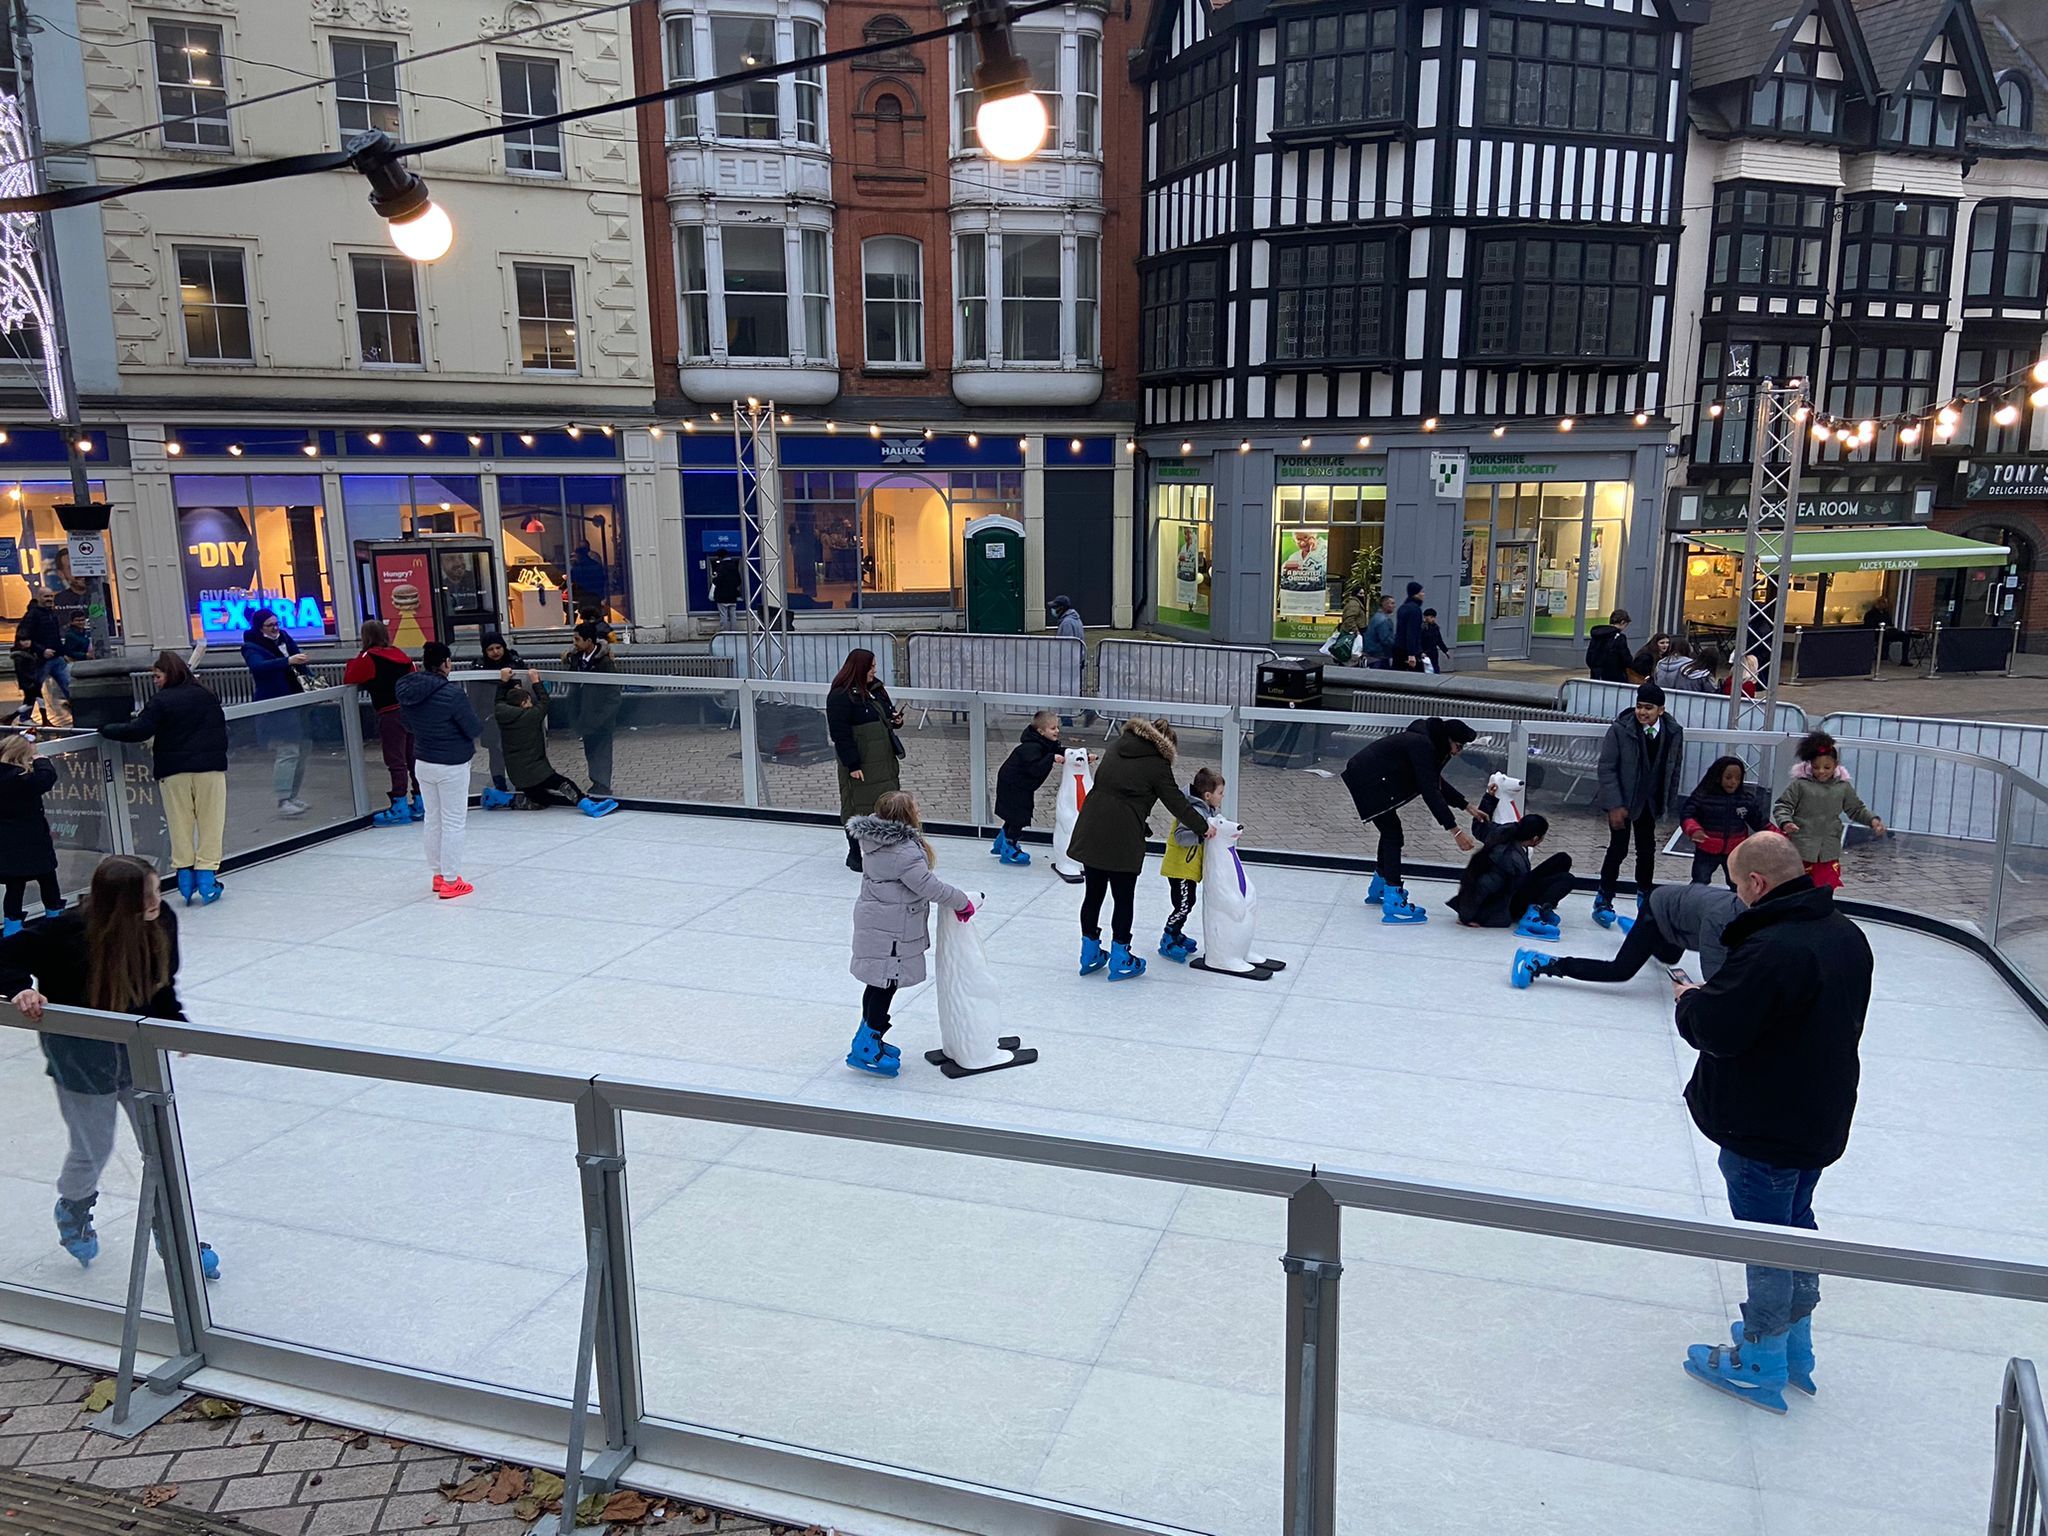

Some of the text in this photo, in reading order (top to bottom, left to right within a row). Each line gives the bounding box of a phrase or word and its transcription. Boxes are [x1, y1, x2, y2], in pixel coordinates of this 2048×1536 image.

[881, 447, 926, 456] HALIFAX
[1282, 457, 1345, 466] YORKSHIRE
[1470, 455, 1526, 465] YORKSHIRE
[1281, 467, 1385, 477] BUILDING SOCIETY
[1470, 464, 1558, 475] BUILDING SOCIETY
[1989, 486, 2048, 495] DELICATESSEN
[1738, 500, 1859, 519] ACE'S EA ROOM
[199, 541, 247, 567] DIY
[1884, 560, 1897, 569] TEA
[1898, 560, 1919, 569] ROOM
[383, 570, 413, 578] Hungry?
[200, 598, 323, 631] EXTRA
[50, 821, 79, 838] enjoy
